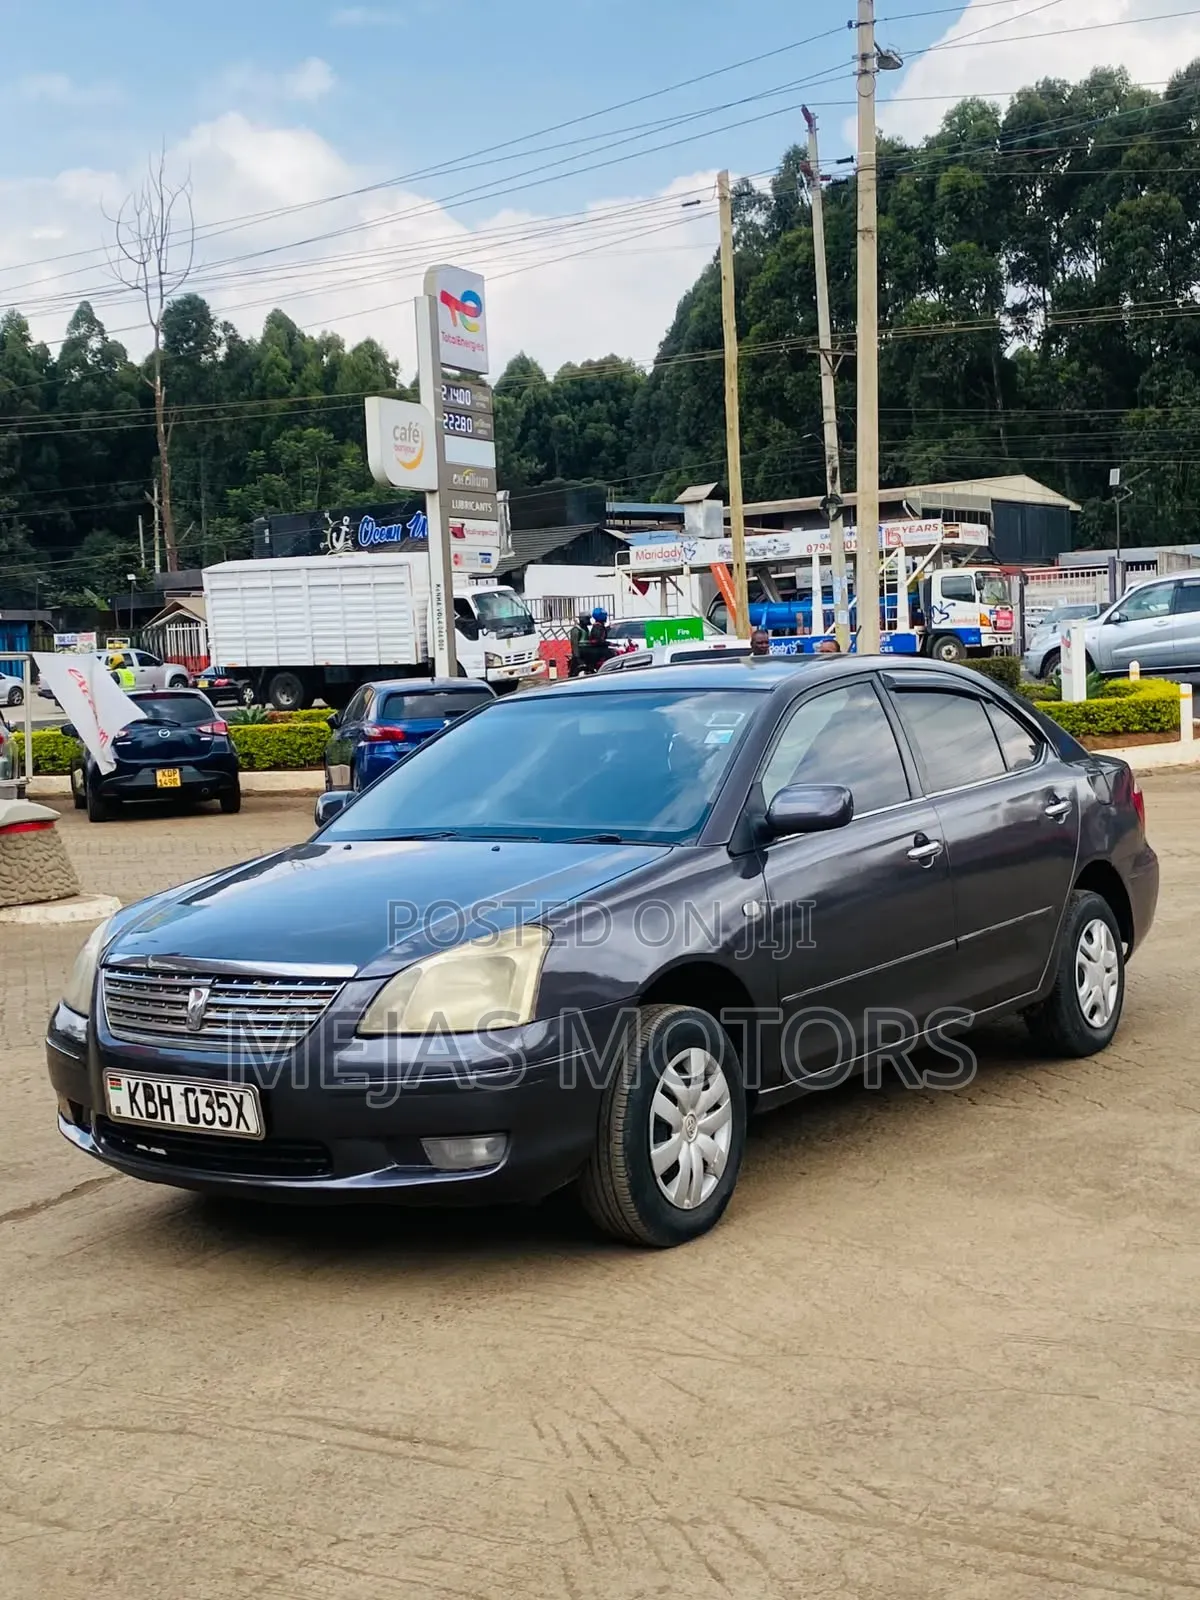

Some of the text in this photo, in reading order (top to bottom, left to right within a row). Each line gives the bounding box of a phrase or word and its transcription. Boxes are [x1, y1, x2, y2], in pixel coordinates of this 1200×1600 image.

[441, 331, 484, 352] TotalEnergies
[393, 421, 420, 444] café
[451, 499, 493, 512] LUBRICANTS
[358, 515, 402, 547] Ocean
[901, 523, 939, 534] YEARS
[635, 545, 682, 561] Maridady
[677, 628, 690, 636] Fire
[127, 1080, 251, 1132] KBH 035X
